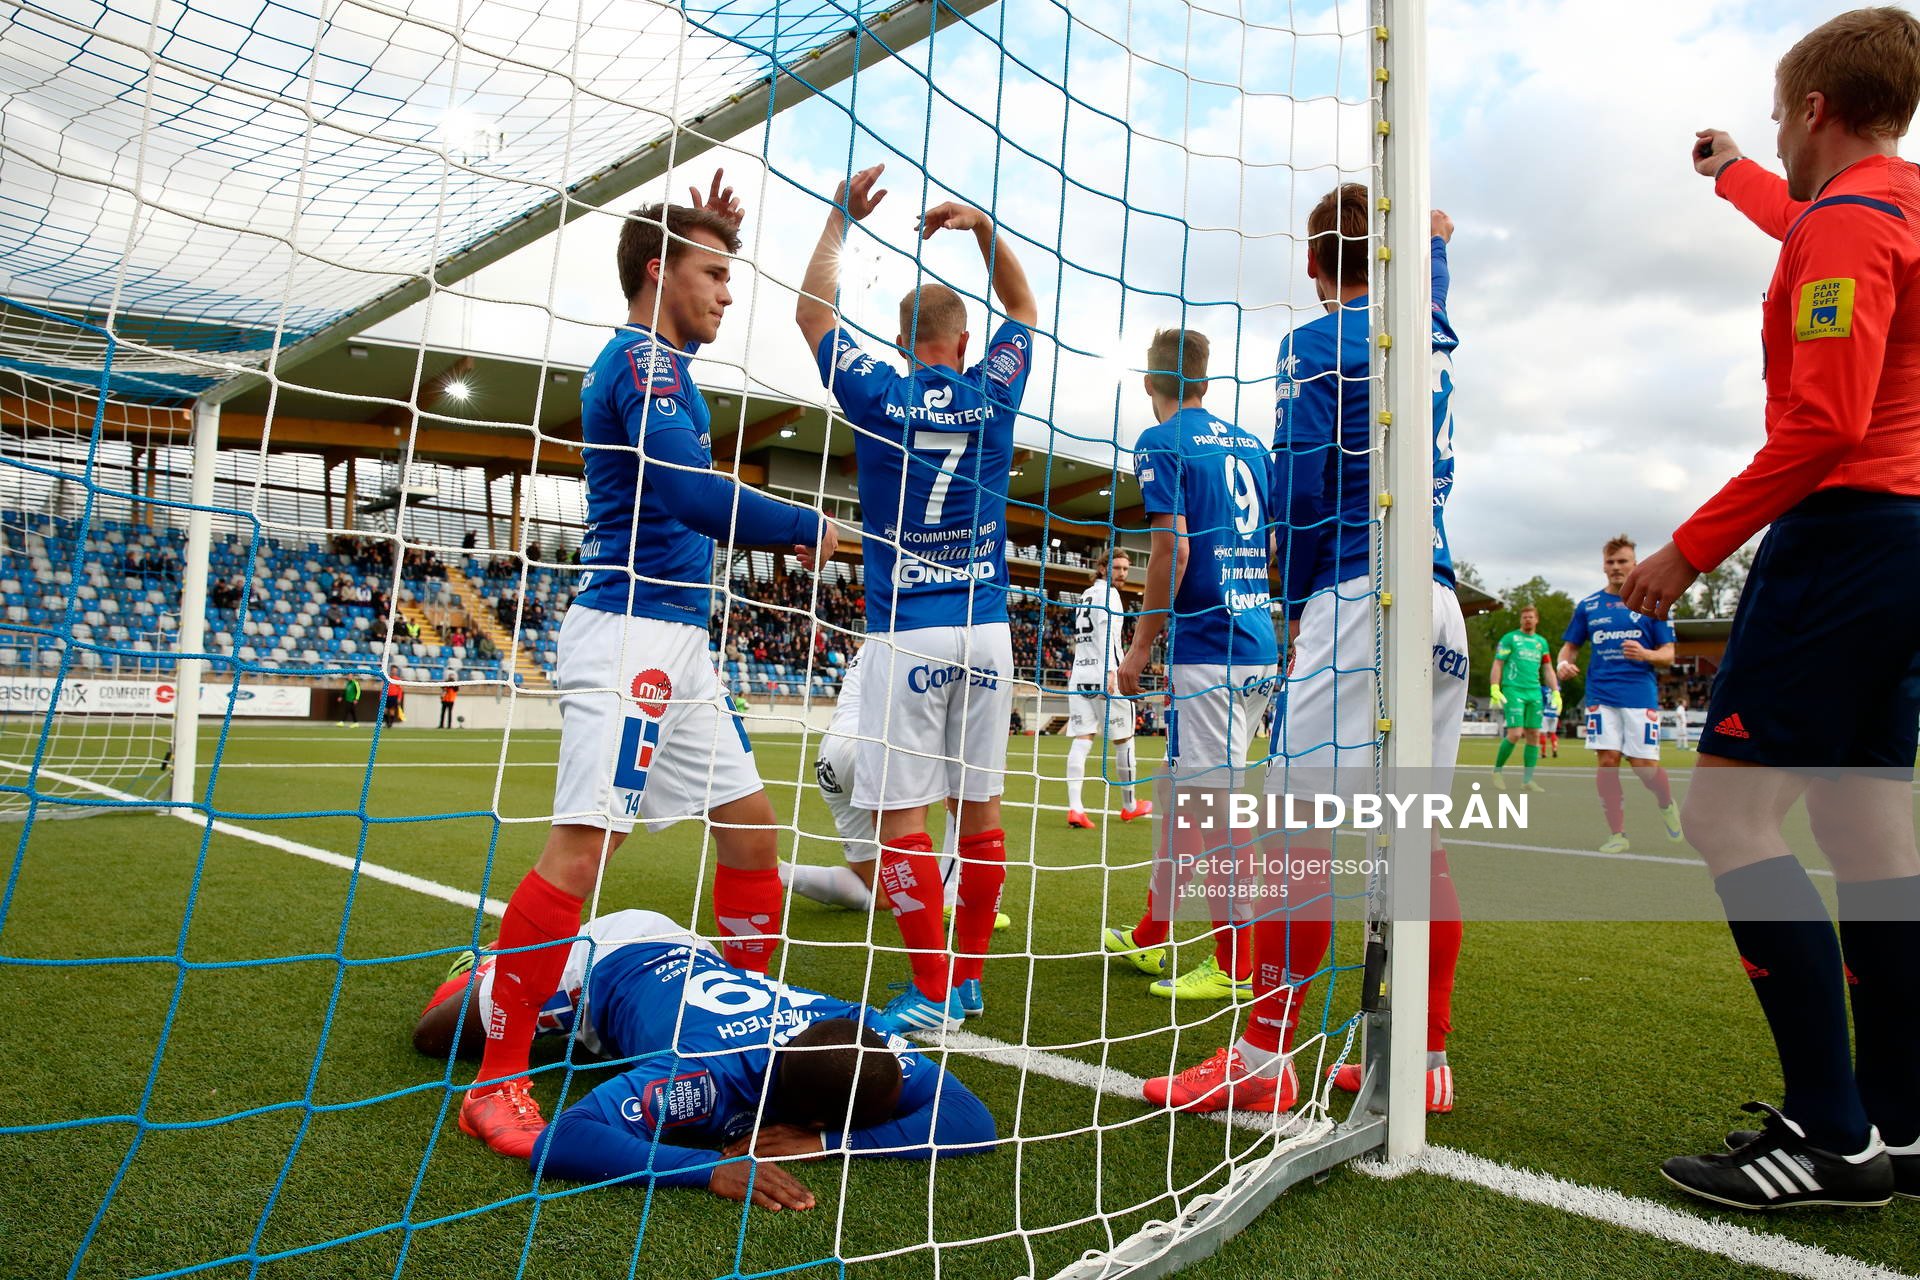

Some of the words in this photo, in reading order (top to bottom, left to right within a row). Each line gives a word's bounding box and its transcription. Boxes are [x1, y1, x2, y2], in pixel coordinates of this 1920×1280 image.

[1813, 290, 1840, 299] PLAY
[1814, 283, 1840, 291] FAIR
[886, 402, 994, 425] PARTNERTECH
[914, 432, 968, 524] 7
[1225, 454, 1260, 540] 9
[903, 529, 974, 543] KOMMUNEN
[979, 521, 997, 537] MED
[100, 686, 151, 699] COMFORT
[1714, 725, 1749, 739] adidas
[625, 792, 641, 816] 14
[668, 1090, 678, 1116] KLUBB
[676, 1081, 686, 1120] FOTBOLLS
[683, 1081, 694, 1117] SVERIGES
[692, 1088, 701, 1108] HELA
